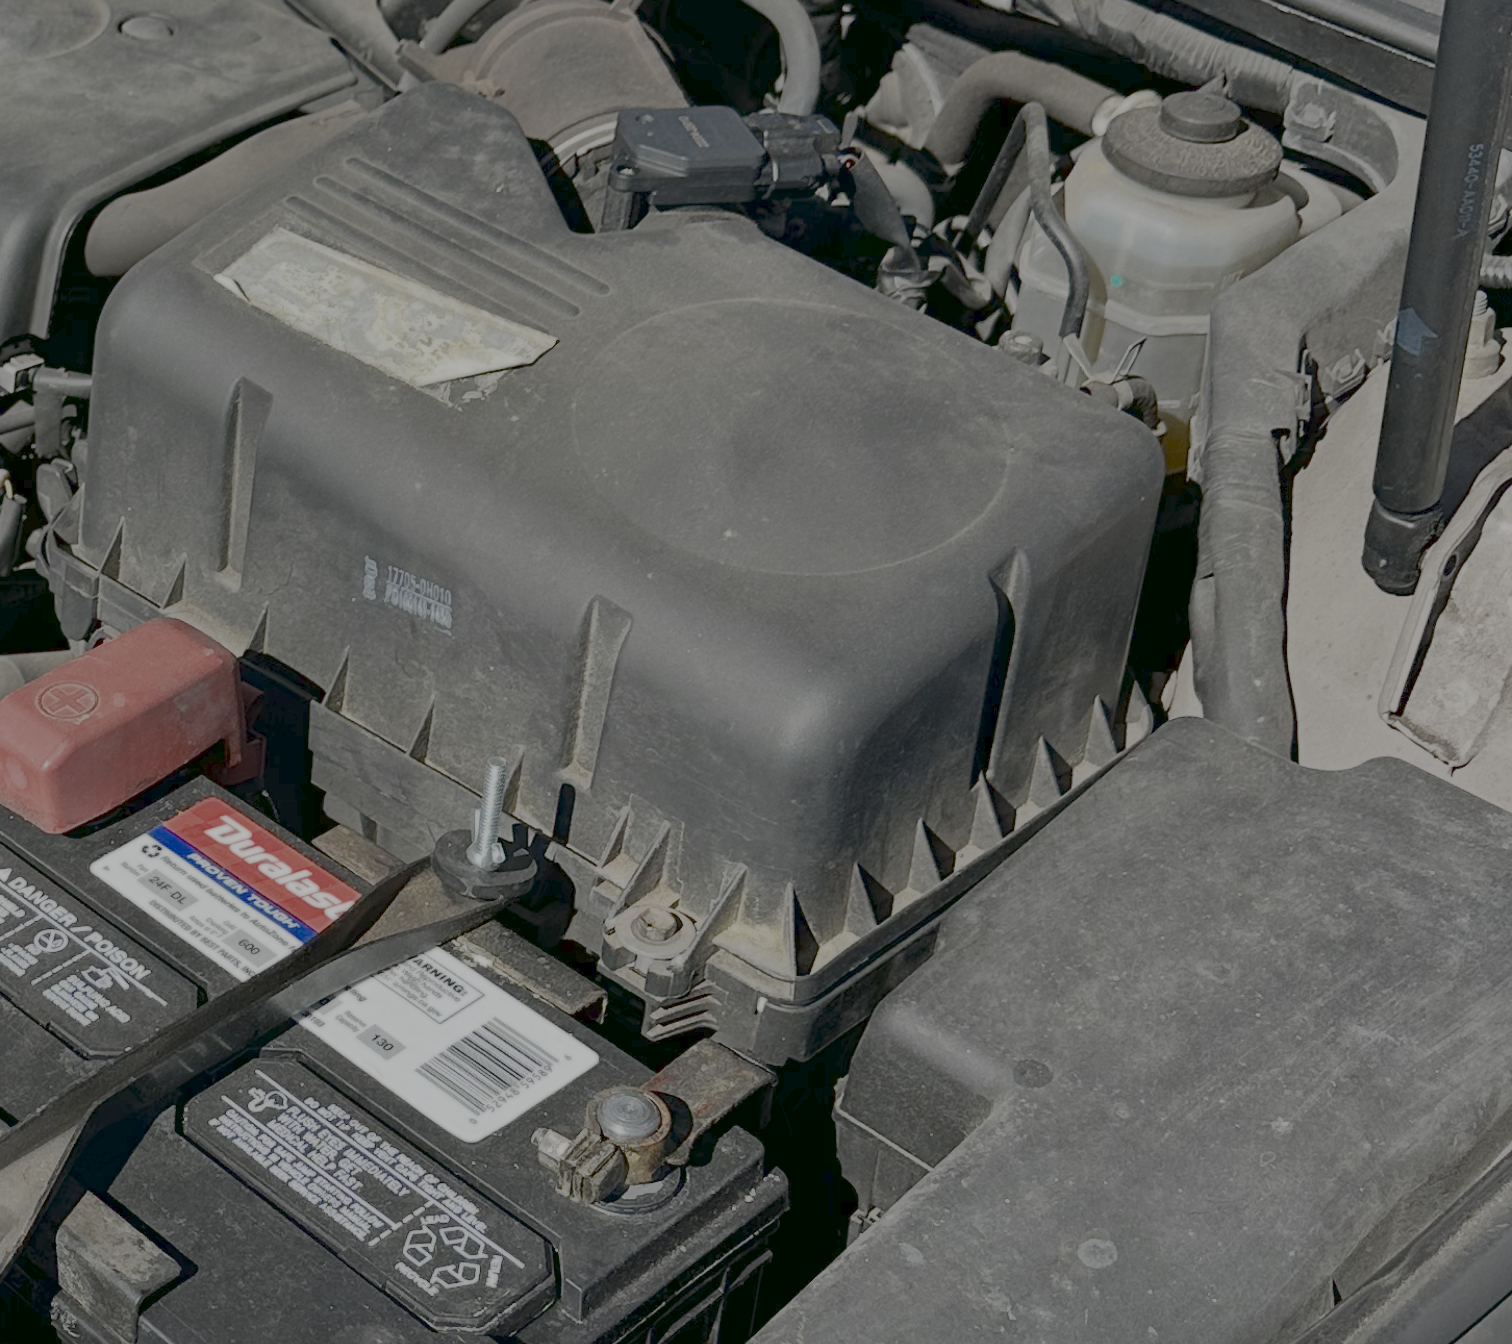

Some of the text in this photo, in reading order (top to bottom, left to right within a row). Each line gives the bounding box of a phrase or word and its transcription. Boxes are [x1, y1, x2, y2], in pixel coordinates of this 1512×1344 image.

[186, 852, 248, 894] PROVEN
[8, 876, 78, 928] DANGER
[83, 930, 152, 980] POISON
[199, 937, 219, 950] BEST
[367, 1033, 396, 1051] 130
[265, 1119, 312, 1153] MEDICAL
[306, 1149, 337, 1172] HELP
[276, 1112, 306, 1135] WITH
[336, 1157, 362, 1176] GET
[285, 1105, 411, 1198] FLUSH EYES IMMEDIATELY
